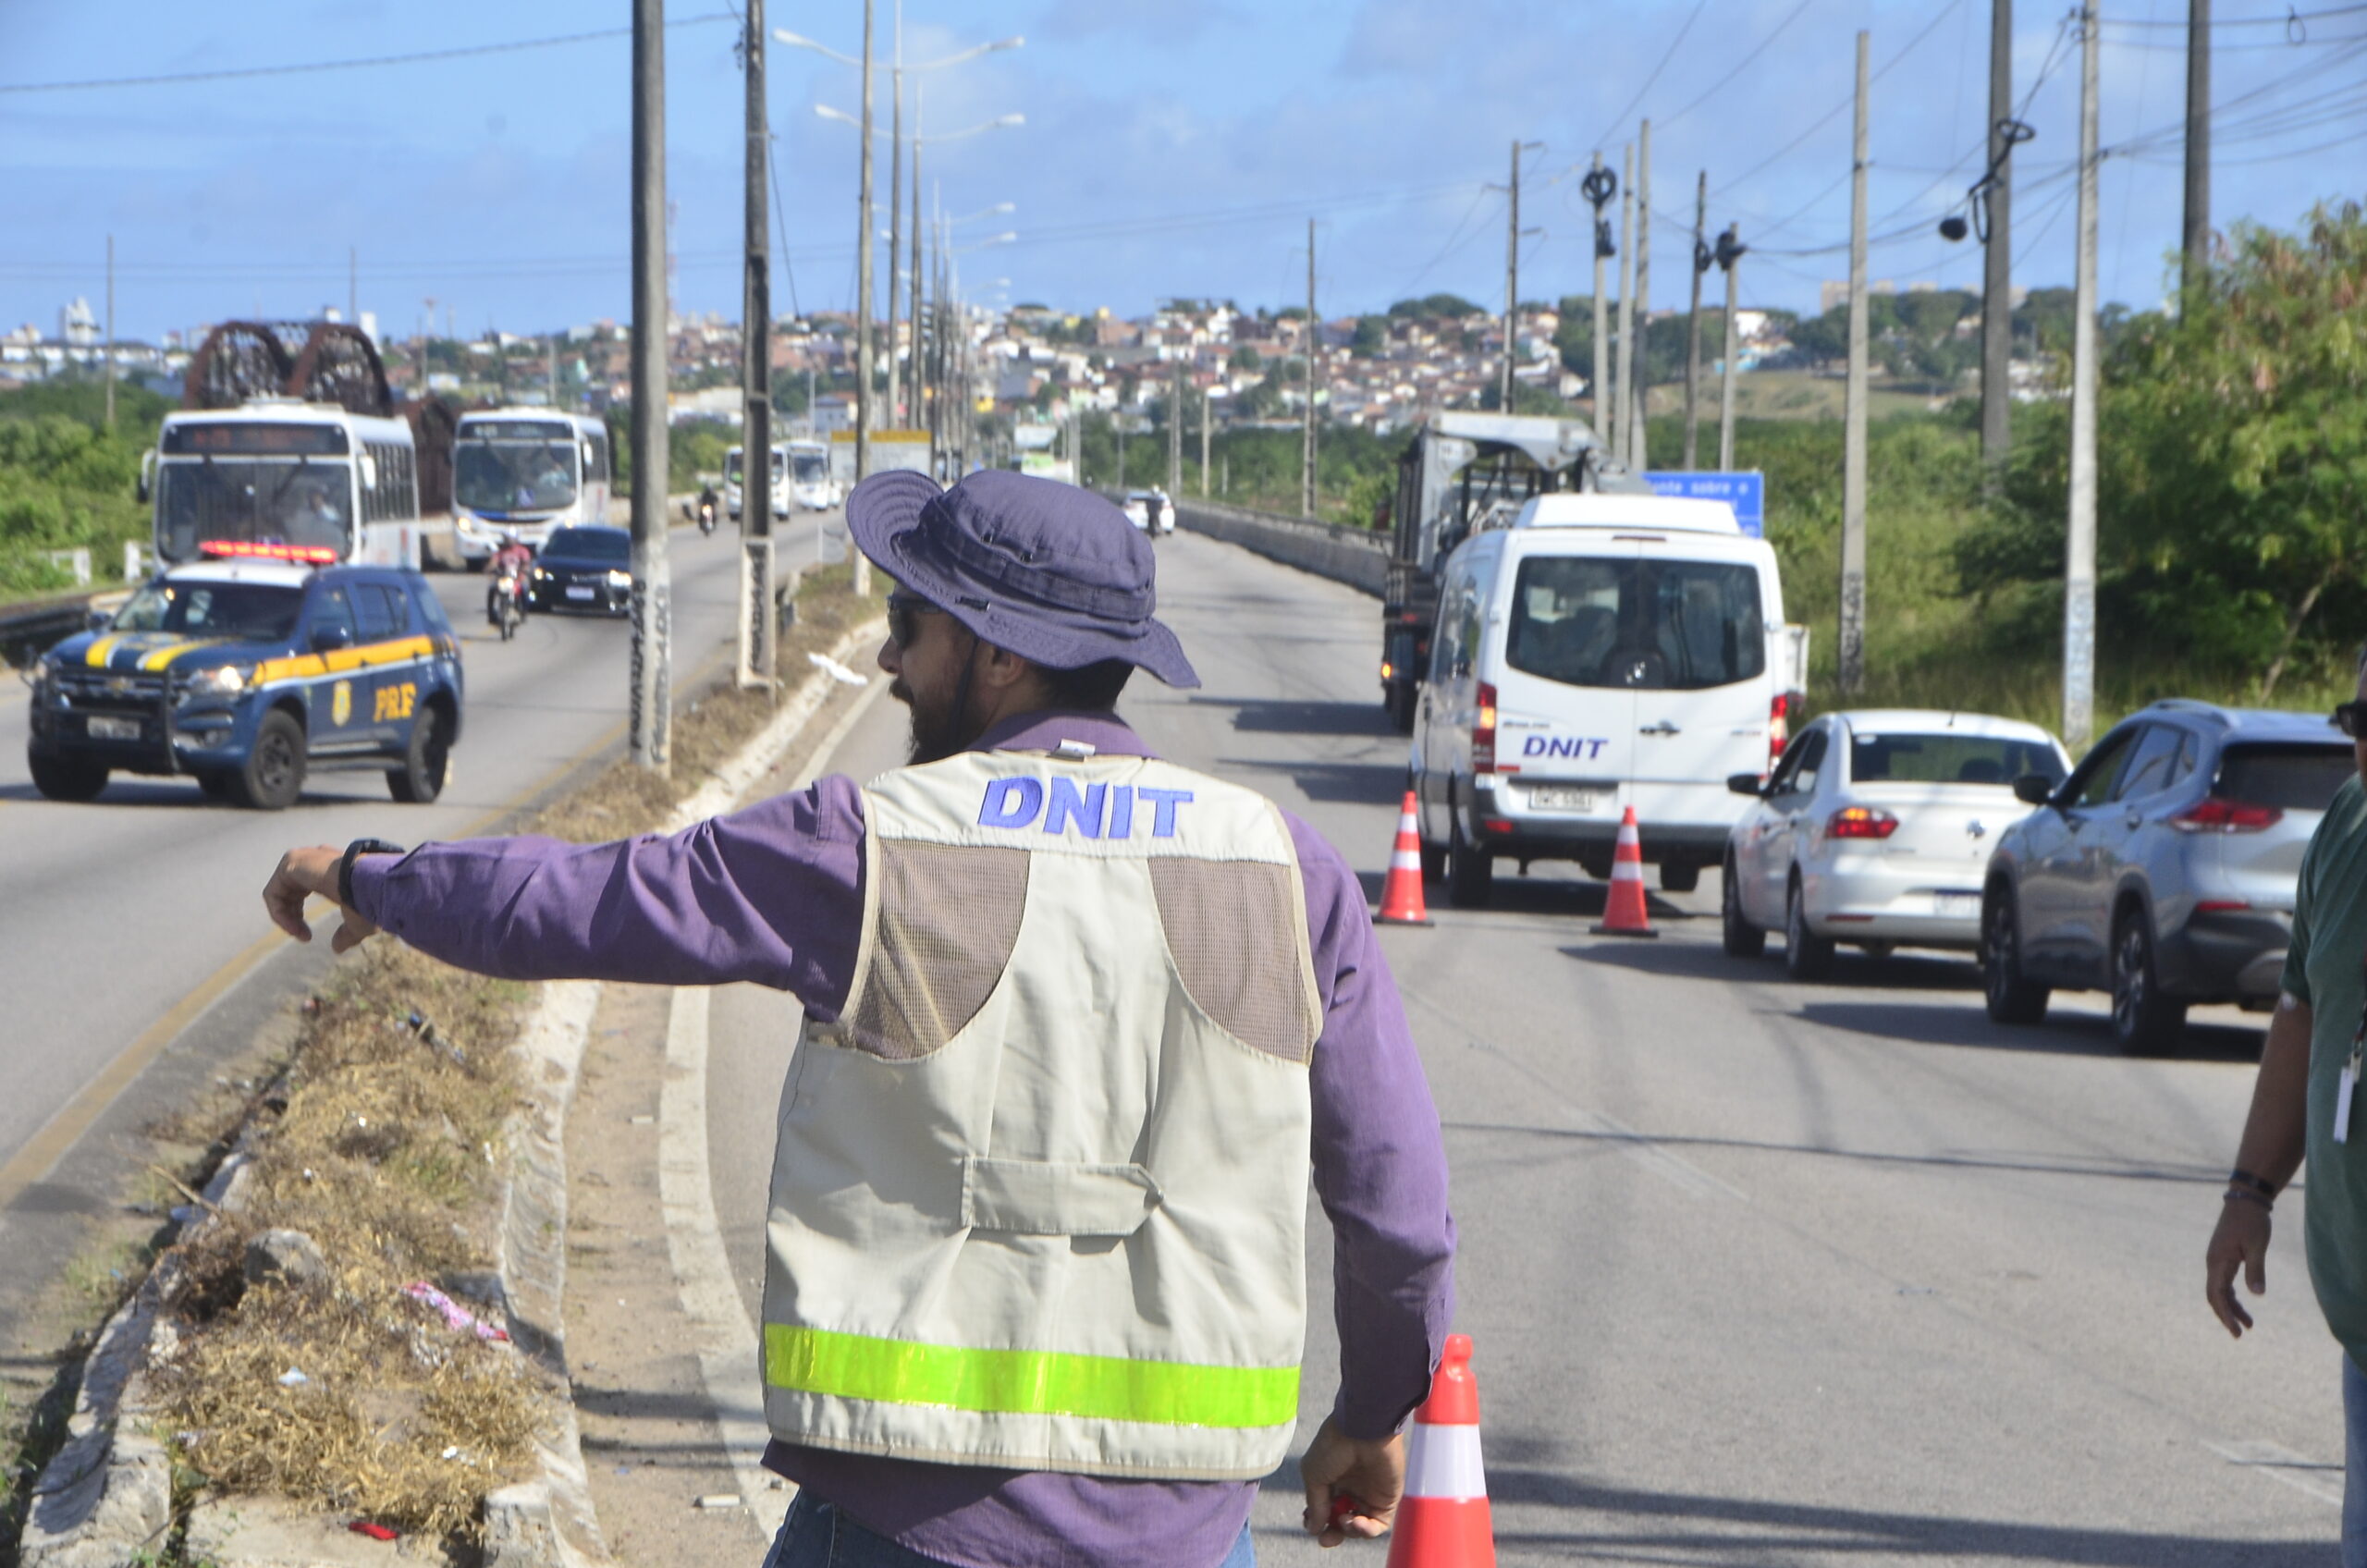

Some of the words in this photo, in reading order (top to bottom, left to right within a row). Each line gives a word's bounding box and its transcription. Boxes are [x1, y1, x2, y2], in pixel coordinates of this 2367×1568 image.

[373, 682, 416, 723] PRF
[1523, 736, 1608, 759] DNIT
[977, 775, 1195, 839] DNIT
